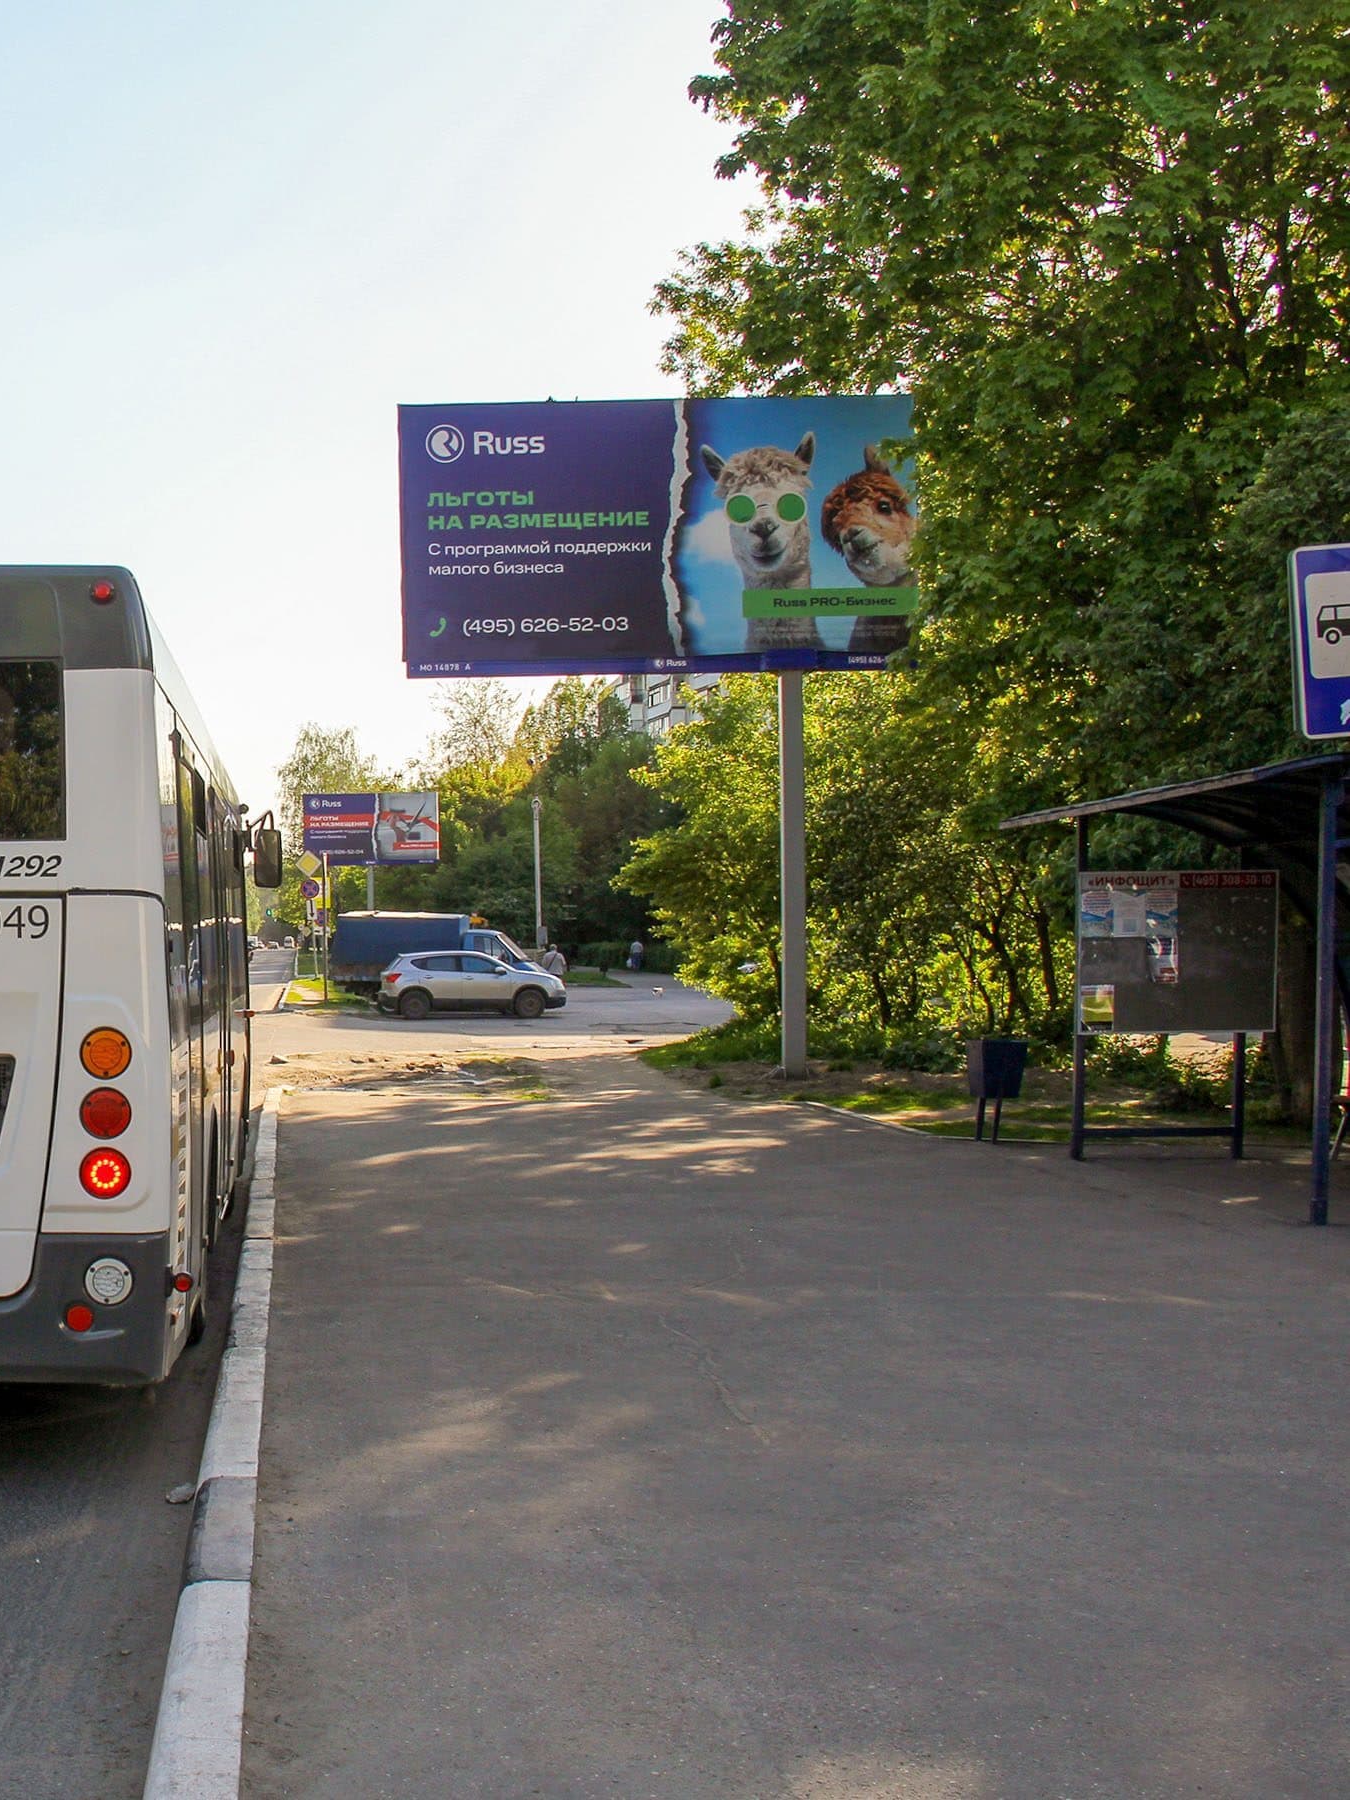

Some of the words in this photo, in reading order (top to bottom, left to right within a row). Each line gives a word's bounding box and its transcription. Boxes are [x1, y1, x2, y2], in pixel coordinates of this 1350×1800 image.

[473, 430, 545, 456] Russ
[427, 491, 534, 507] ЛЬГОТЫ
[428, 514, 464, 530] НА
[471, 511, 649, 530] РАЗМЕЩЕНИЕ
[428, 543, 441, 556] С
[445, 541, 550, 559] программой
[554, 541, 651, 558] поддержки
[428, 565, 490, 576] малого
[494, 561, 564, 576] бизнеса
[773, 597, 807, 608] Russ
[809, 595, 897, 607] PRO-Бизнес
[462, 619, 515, 637] (495)
[520, 616, 629, 634] 626-52-03
[666, 659, 687, 667] Russ
[321, 800, 342, 808] Russ
